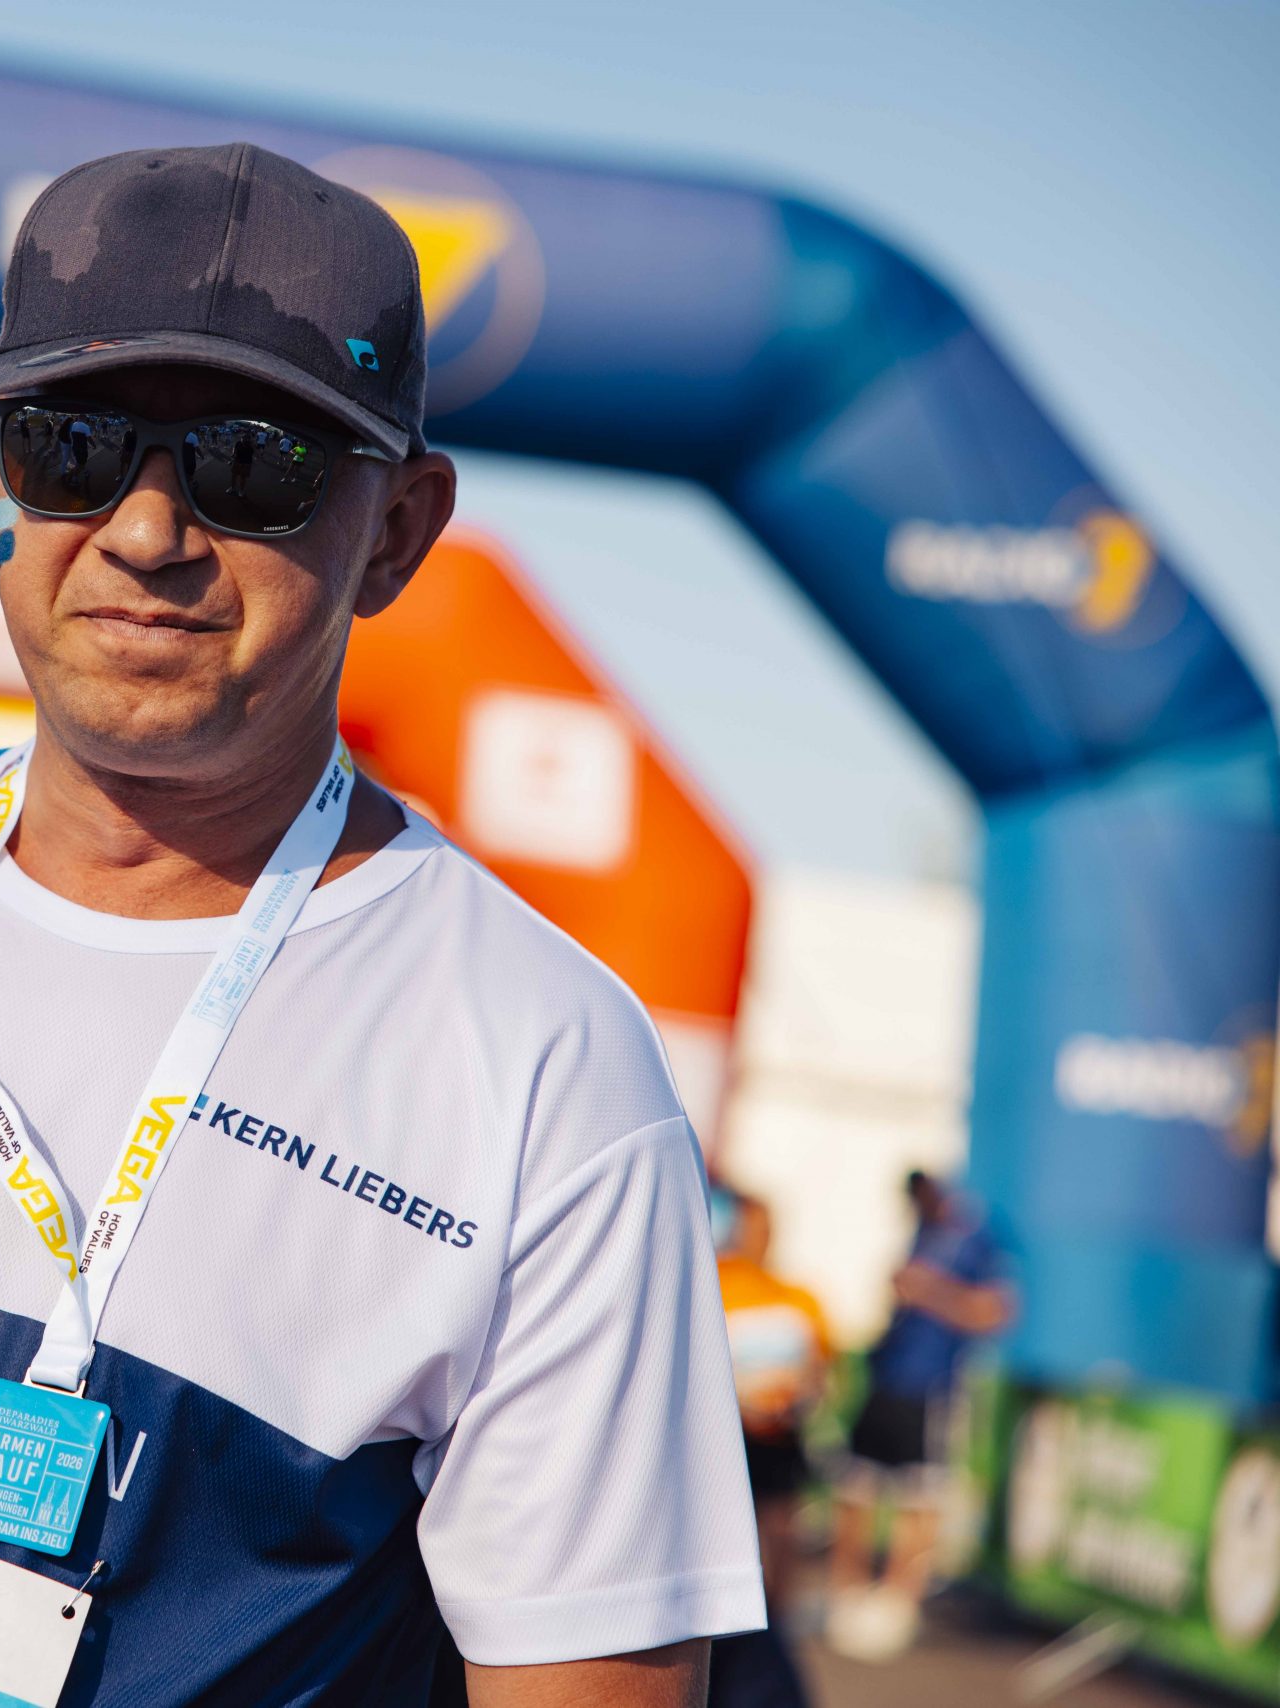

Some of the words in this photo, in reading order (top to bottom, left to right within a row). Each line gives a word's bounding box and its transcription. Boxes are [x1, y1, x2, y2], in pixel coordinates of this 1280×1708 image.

[234, 939, 257, 969] LAUF
[11, 1139, 22, 1155] OF
[106, 1095, 188, 1205] VEGA
[208, 1101, 317, 1171] KERN
[320, 1153, 479, 1250] LIEBERS
[7, 1154, 78, 1283] VEGA
[98, 1210, 110, 1227] OF
[101, 1213, 122, 1251] HOME
[78, 1227, 103, 1274] VALUES
[56, 1452, 84, 1471] 2026
[20, 1527, 38, 1543] INS
[39, 1532, 68, 1550] ZIEL!
